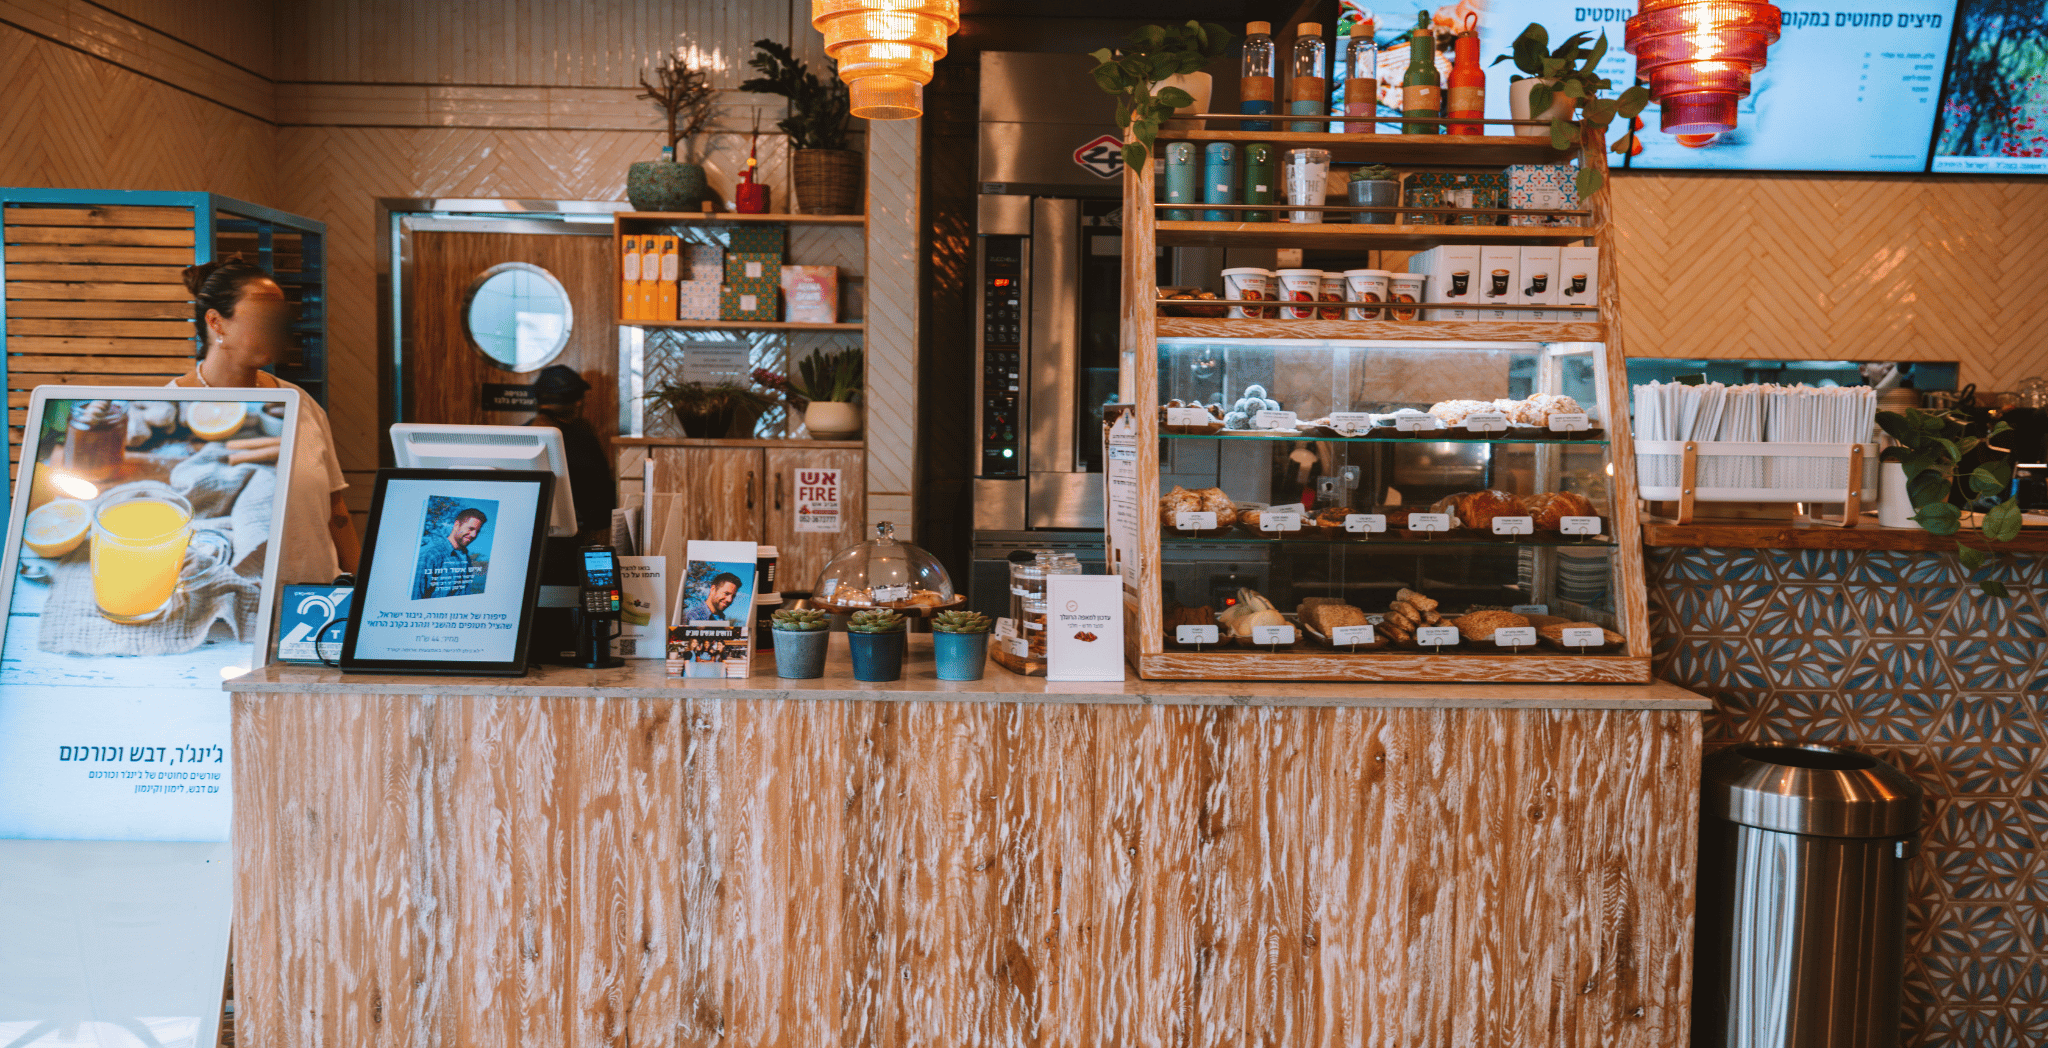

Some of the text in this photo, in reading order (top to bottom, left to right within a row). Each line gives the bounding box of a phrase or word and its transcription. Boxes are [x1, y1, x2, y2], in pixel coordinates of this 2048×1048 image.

[1575, 7, 1632, 22] טוסטים
[1781, 11, 1942, 29] מיצים סחוטים במקום
[800, 472, 836, 485] אש
[799, 487, 836, 501] FIRE
[450, 612, 468, 620] ארנון
[470, 612, 481, 620] של
[389, 620, 409, 629] בקרב
[432, 621, 456, 629] מהשבי
[488, 621, 513, 630] שהציל
[330, 630, 341, 640] T
[59, 744, 224, 766] ג'ינג'ר, דבש וכורכום
[88, 770, 221, 780] שורשים סחוטים של ג'ינג'ר וכורכום
[134, 784, 220, 794] עם דבש, לימון וקינמון
